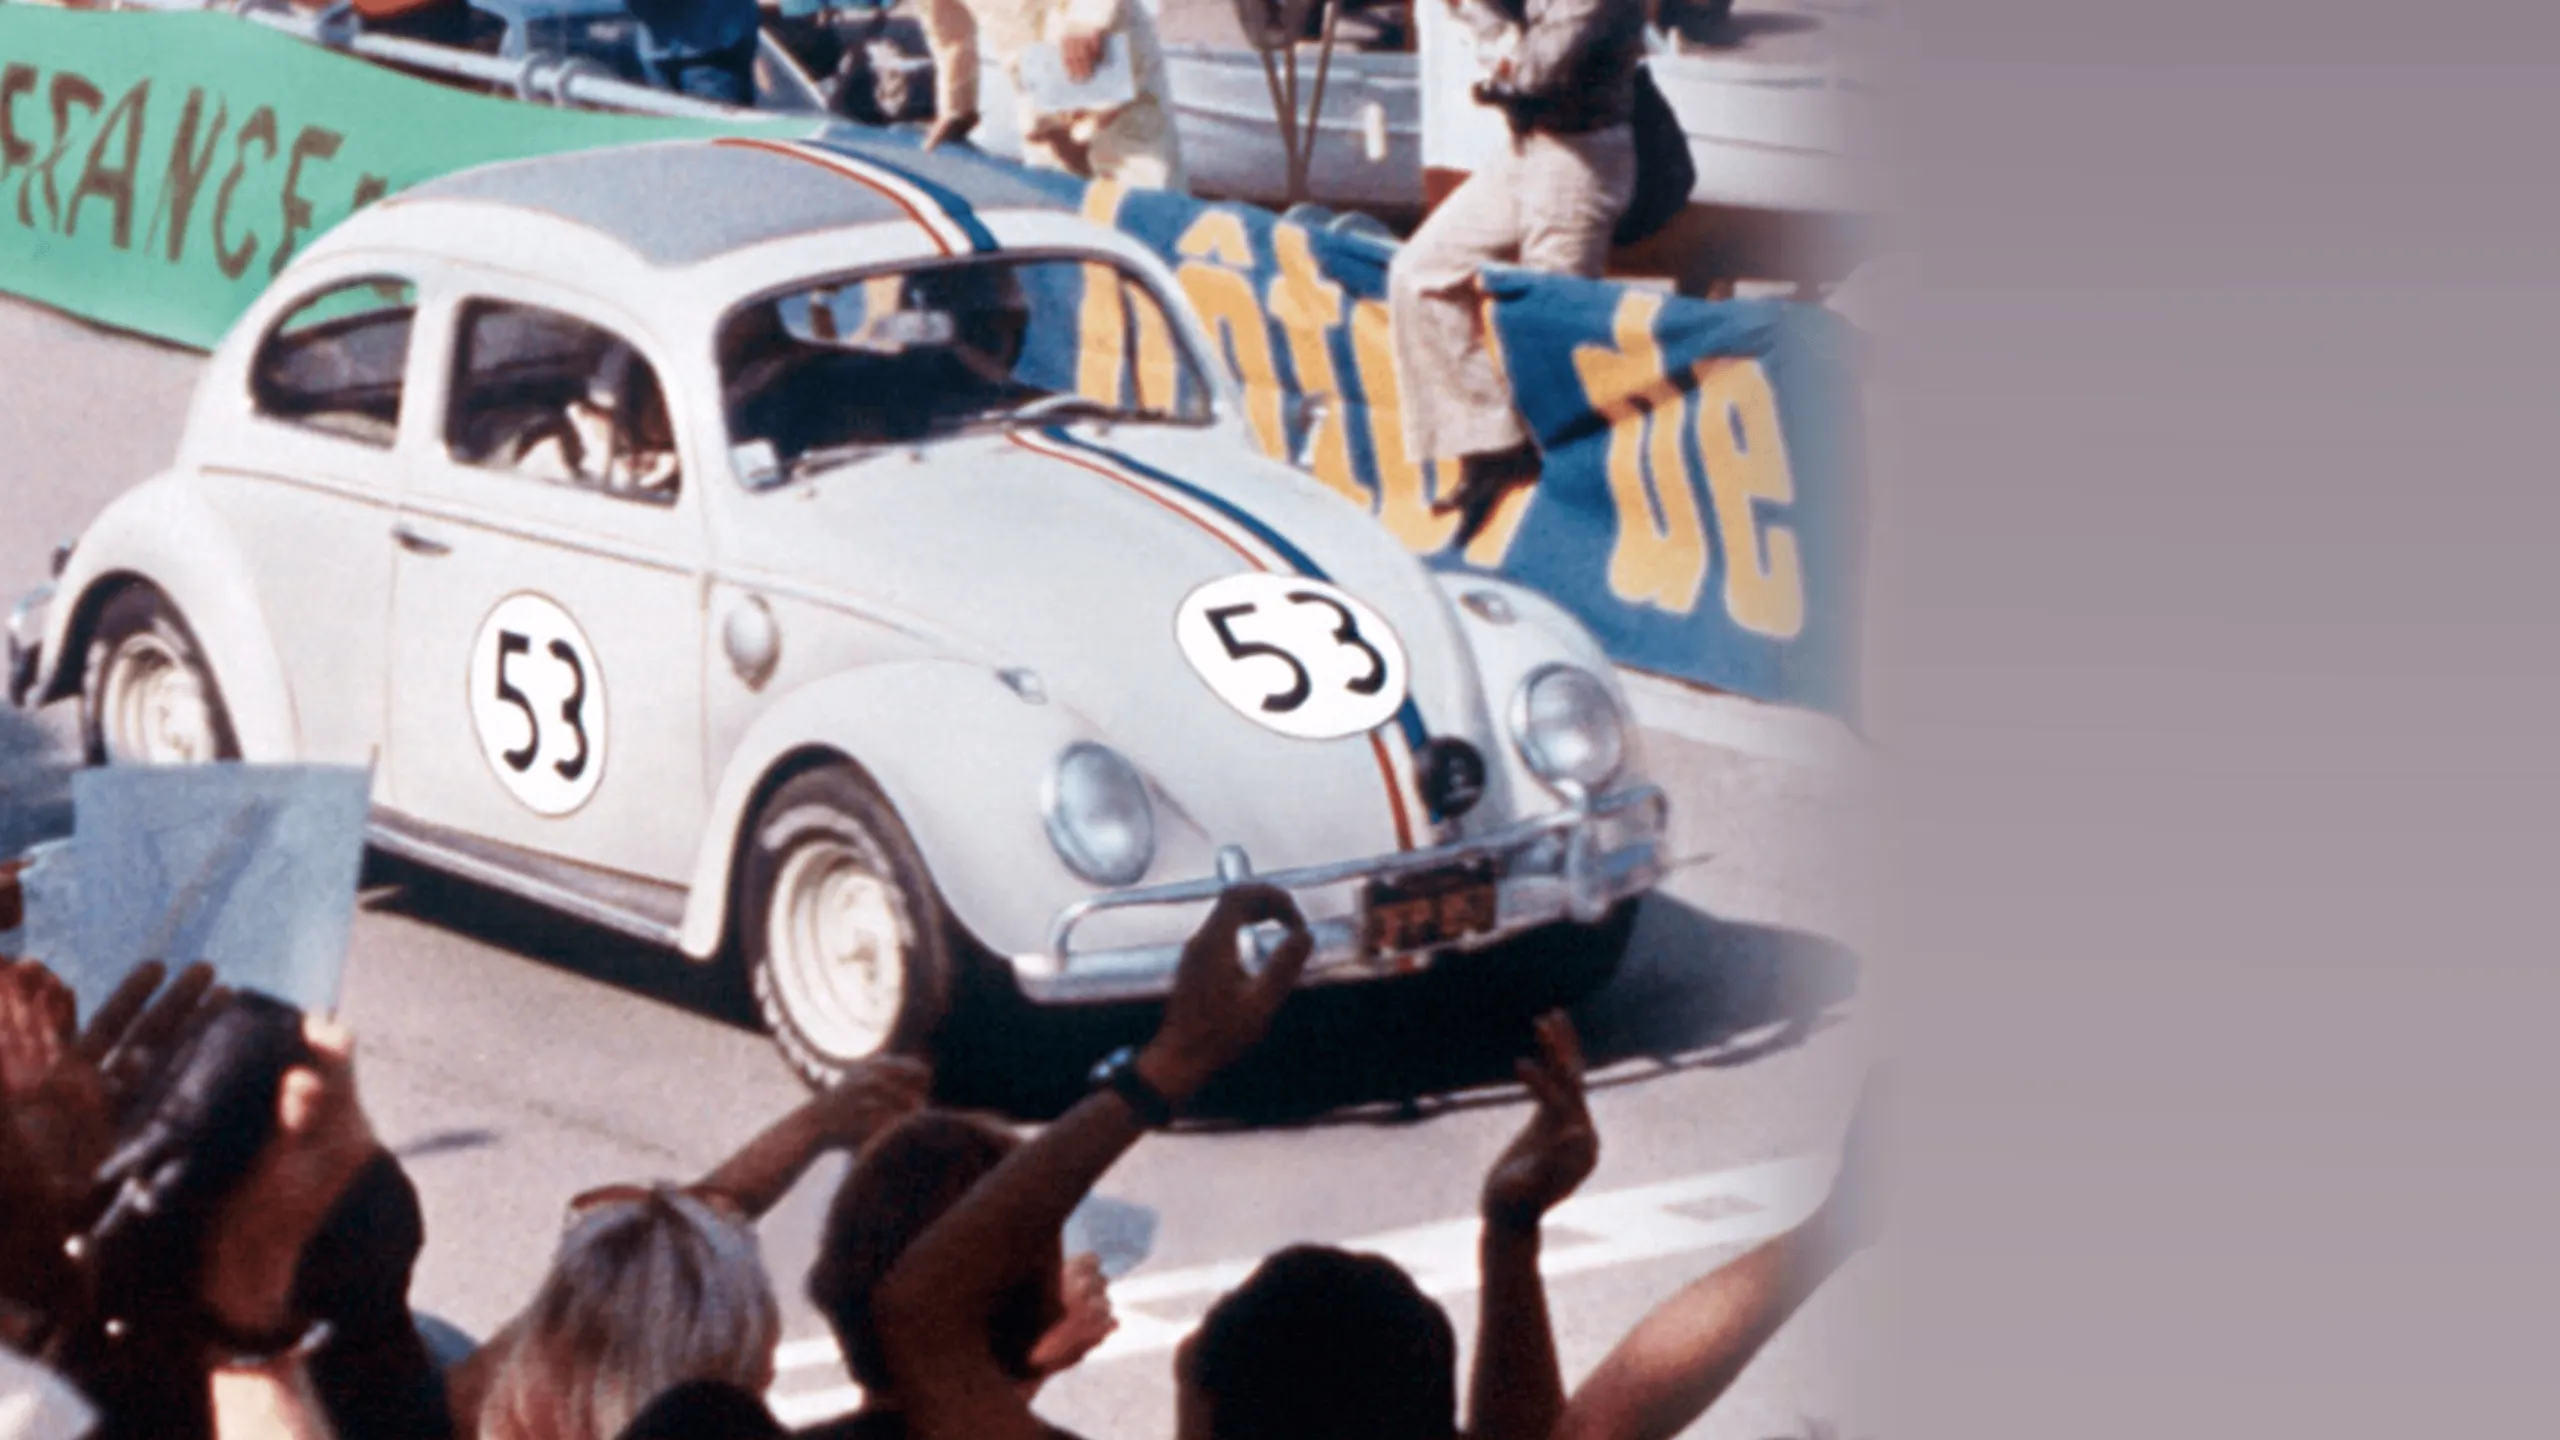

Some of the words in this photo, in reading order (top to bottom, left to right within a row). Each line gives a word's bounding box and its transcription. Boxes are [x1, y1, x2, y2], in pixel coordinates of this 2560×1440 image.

[0, 62, 346, 281] FRANCE
[1571, 288, 1804, 638] de
[496, 629, 589, 782] 53
[1204, 590, 1388, 713] 53
